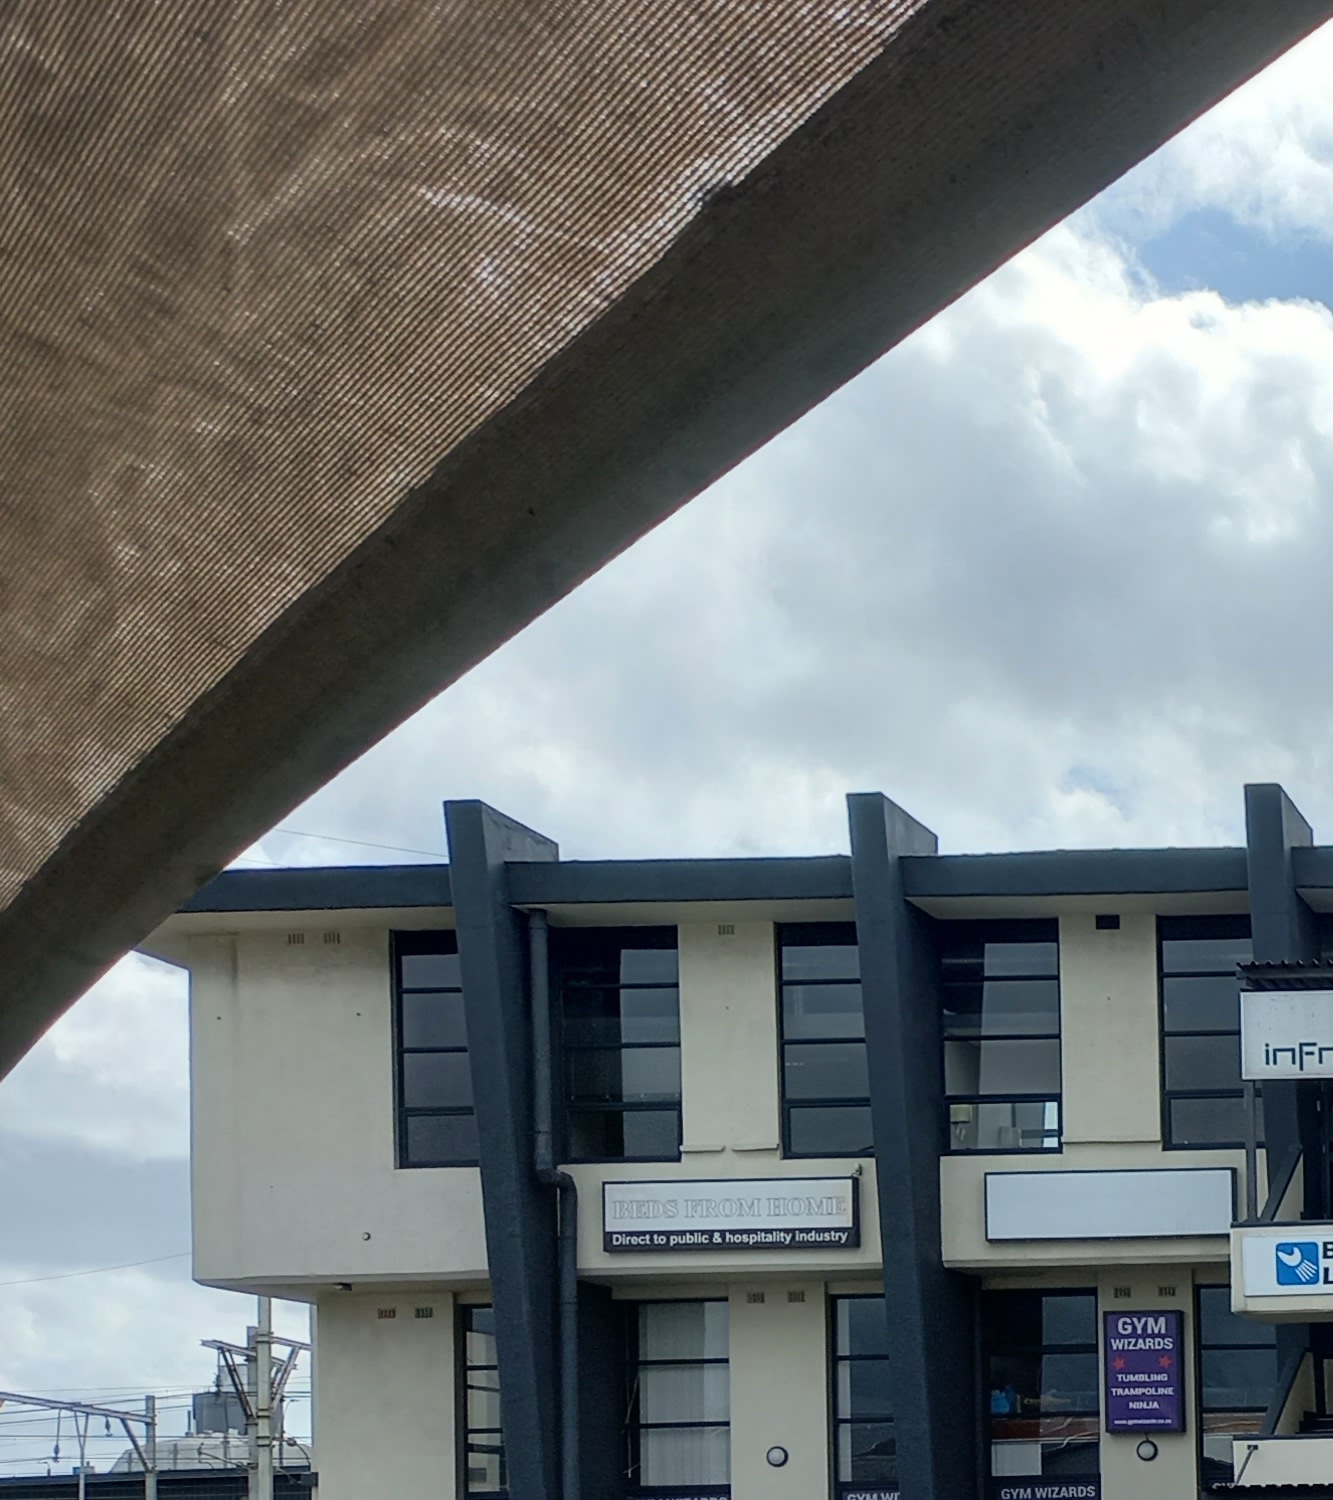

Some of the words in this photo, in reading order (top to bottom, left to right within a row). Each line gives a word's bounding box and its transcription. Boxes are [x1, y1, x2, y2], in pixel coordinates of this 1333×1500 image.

[612, 1199, 679, 1219] BEDS
[684, 1197, 762, 1218] FROM
[766, 1196, 847, 1217] HOME
[612, 1233, 651, 1245] Direct
[653, 1233, 665, 1244] to
[670, 1232, 709, 1246] public
[712, 1232, 722, 1243] &
[725, 1230, 792, 1245] hospitality
[795, 1229, 848, 1243] industry
[1117, 1317, 1166, 1335] GYM
[1110, 1338, 1173, 1350] WIZARDS
[1116, 1373, 1168, 1382] TUMBLING
[1111, 1387, 1174, 1396] TRAMPOLINE
[1128, 1401, 1160, 1409] NINJA
[1001, 1488, 1031, 1500] GYM
[1034, 1486, 1096, 1499] WIZARDS
